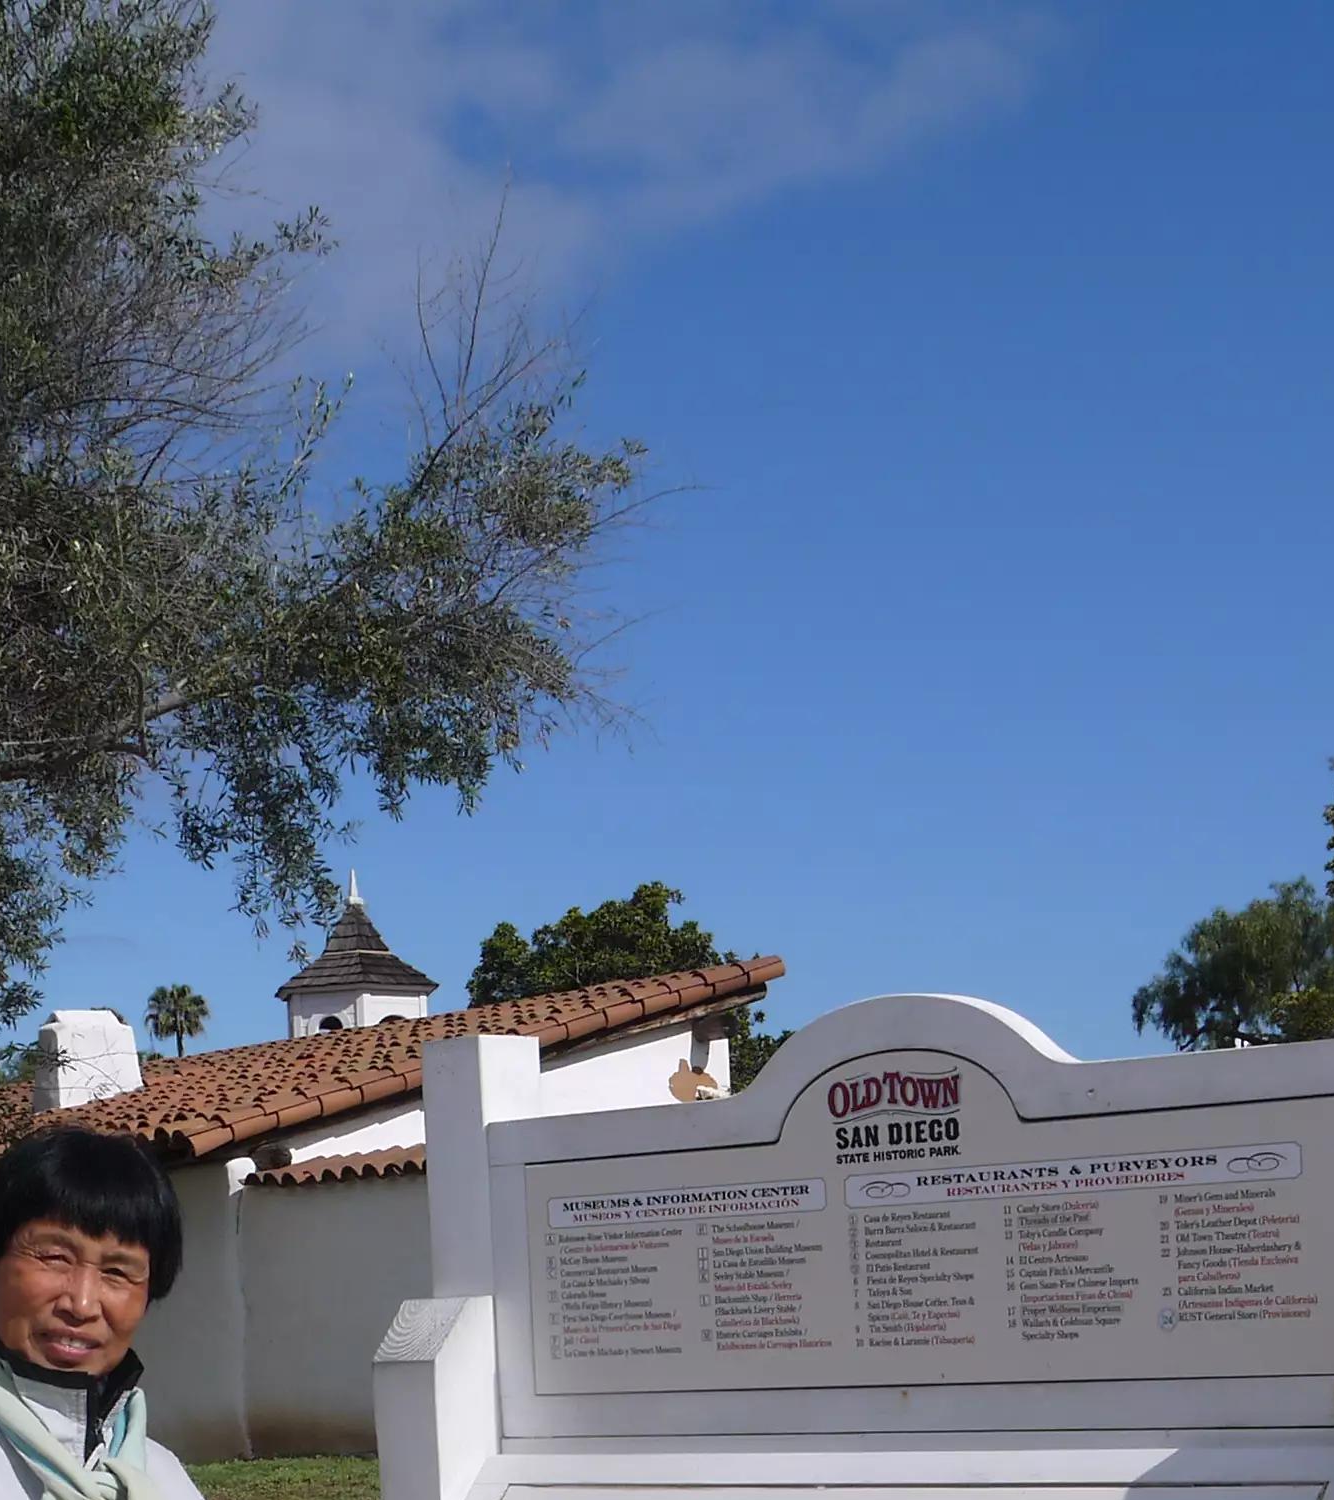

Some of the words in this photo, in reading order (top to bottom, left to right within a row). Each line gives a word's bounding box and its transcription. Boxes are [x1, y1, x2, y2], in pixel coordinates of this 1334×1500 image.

[828, 1077, 881, 1119] OLD
[881, 1071, 961, 1109] TOWN
[836, 1122, 881, 1150] SAN
[888, 1117, 961, 1145] DIEGO
[836, 1152, 870, 1166] STATE
[873, 1148, 926, 1162] HISTORIC
[917, 1166, 1059, 1187] RESTAURANTS
[1069, 1166, 1081, 1175] &
[1090, 1154, 1217, 1174] PURVEYORS
[946, 1181, 1057, 1197] RESTAURANTES
[1075, 1172, 1185, 1188] PROVEEDORES
[563, 1199, 630, 1211] MUSEUMS
[633, 1199, 642, 1207] &
[646, 1189, 748, 1206] INFORMATION
[752, 1185, 809, 1197] CENTER
[573, 1213, 621, 1222] MUSEOS
[624, 1211, 633, 1219] Y
[636, 1207, 685, 1218] CENTRO
[689, 1205, 705, 1214] DE
[709, 1199, 799, 1213] INFORMACIÓN
